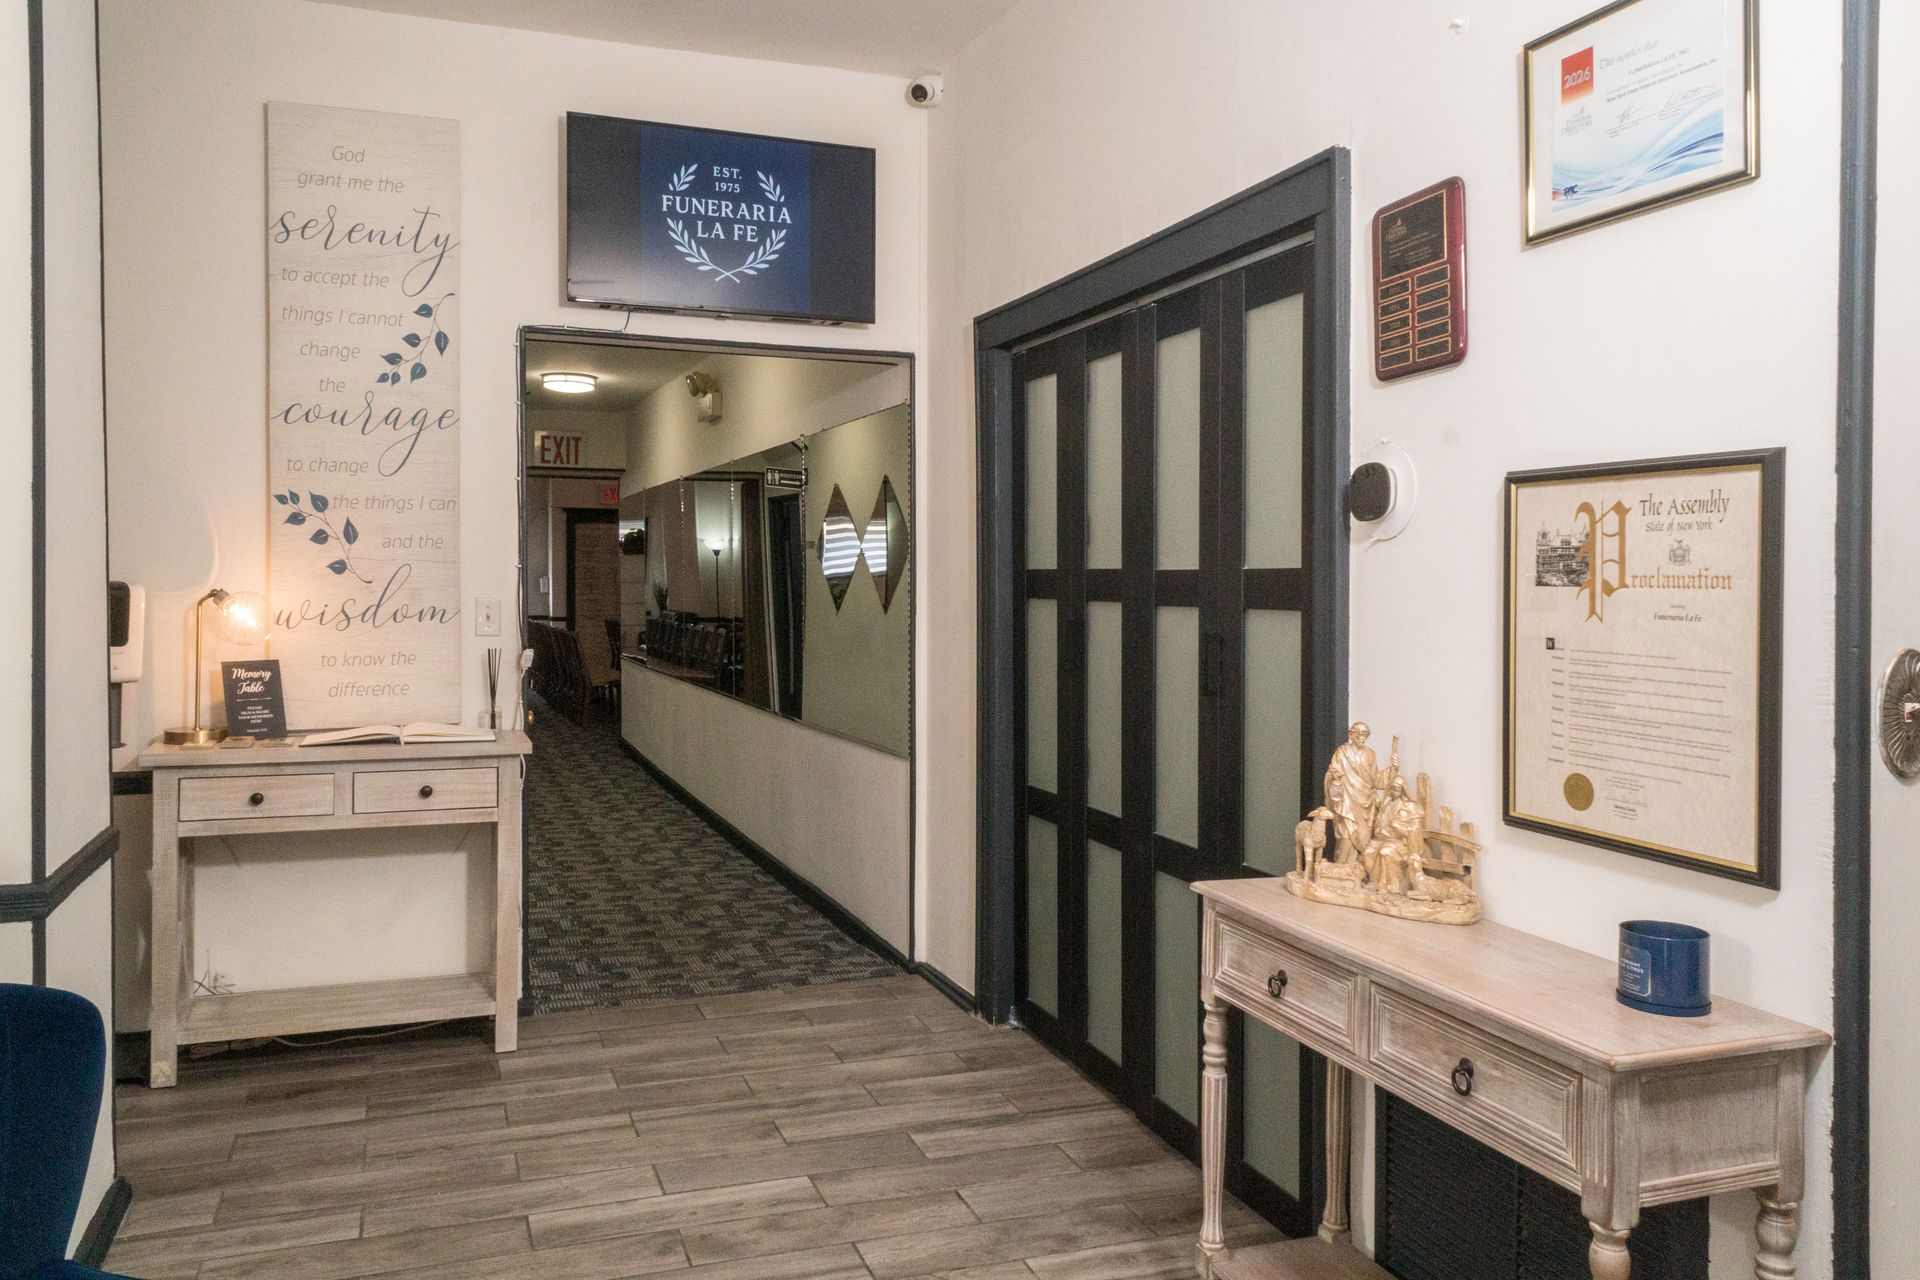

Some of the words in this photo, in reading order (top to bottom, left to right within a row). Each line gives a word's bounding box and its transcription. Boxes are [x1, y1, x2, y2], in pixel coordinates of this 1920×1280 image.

[1563, 67, 1591, 89] 2026
[332, 146, 365, 163] God
[297, 172, 342, 188] grant
[348, 178, 372, 191] me
[378, 177, 404, 193] the
[713, 166, 742, 179] EST.
[715, 182, 741, 193] 1975
[661, 194, 792, 224] FUNERARIA
[696, 220, 726, 240] LA
[733, 224, 758, 243] FE
[269, 205, 460, 297] serenity
[281, 268, 298, 281] to
[303, 269, 357, 288] accept
[363, 272, 390, 288] the
[281, 305, 333, 326] things
[349, 312, 404, 327] cannot
[300, 341, 361, 362] change
[319, 378, 346, 393] the
[270, 390, 460, 477] courage
[540, 435, 582, 465] EXIT
[287, 458, 303, 472] to
[309, 457, 369, 477] change
[332, 494, 359, 510] the
[365, 494, 414, 514] things
[428, 498, 457, 511] can
[1640, 493, 1663, 516] The
[1667, 489, 1730, 523] Assembly
[1645, 521, 1665, 532] State
[1667, 518, 1674, 536] of
[1677, 520, 1692, 532] New
[1695, 518, 1713, 531] York
[382, 535, 413, 549] and
[418, 535, 444, 549] the
[1575, 500, 1733, 624] Proclamation
[275, 563, 459, 632] wisdom
[321, 654, 337, 667] to
[342, 652, 386, 667] know
[390, 651, 417, 666] the
[232, 668, 272, 681] Memory
[237, 681, 265, 694] Table
[328, 681, 410, 698] difference
